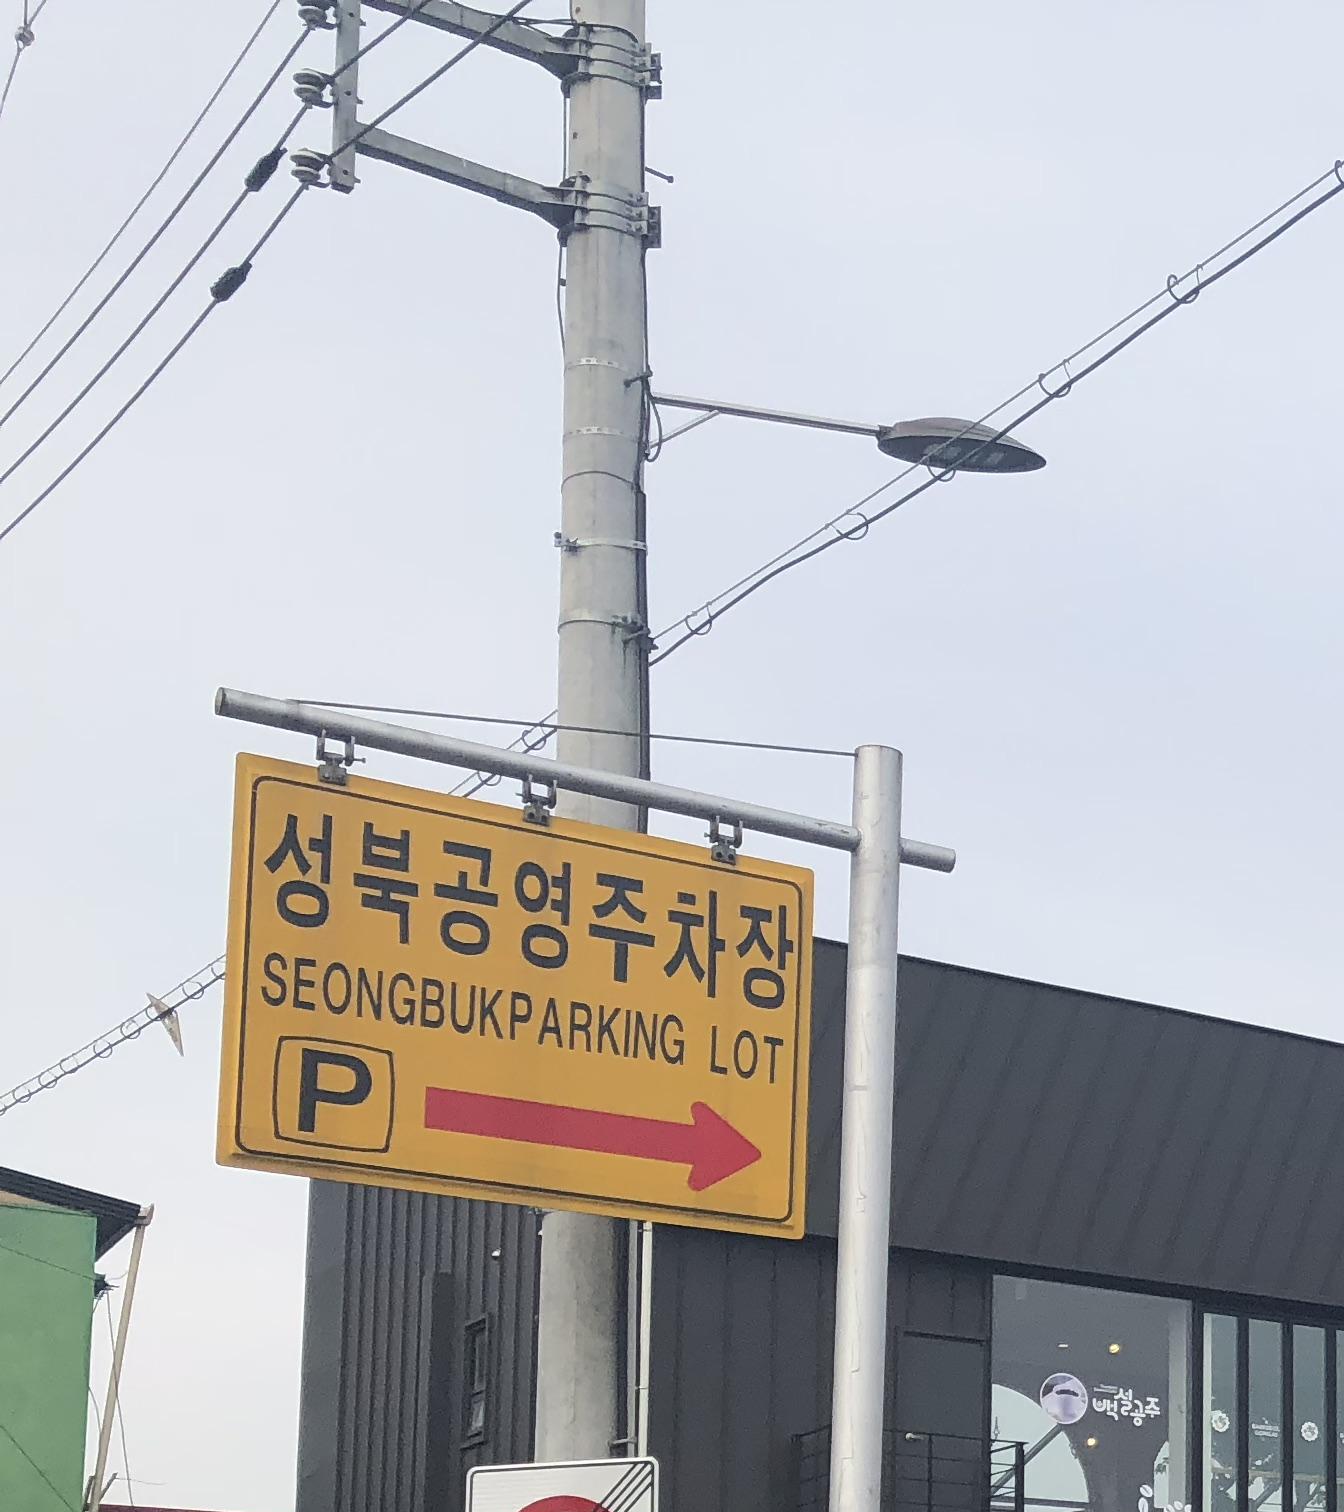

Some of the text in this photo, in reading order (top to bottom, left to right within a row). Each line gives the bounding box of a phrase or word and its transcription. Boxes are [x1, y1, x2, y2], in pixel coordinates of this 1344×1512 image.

[265, 813, 793, 1010] 성북공영주차장
[261, 952, 783, 1084] SEONGBUKPARKING LOT
[297, 1047, 373, 1132] P
[1092, 1387, 1161, 1427] 백설공주
